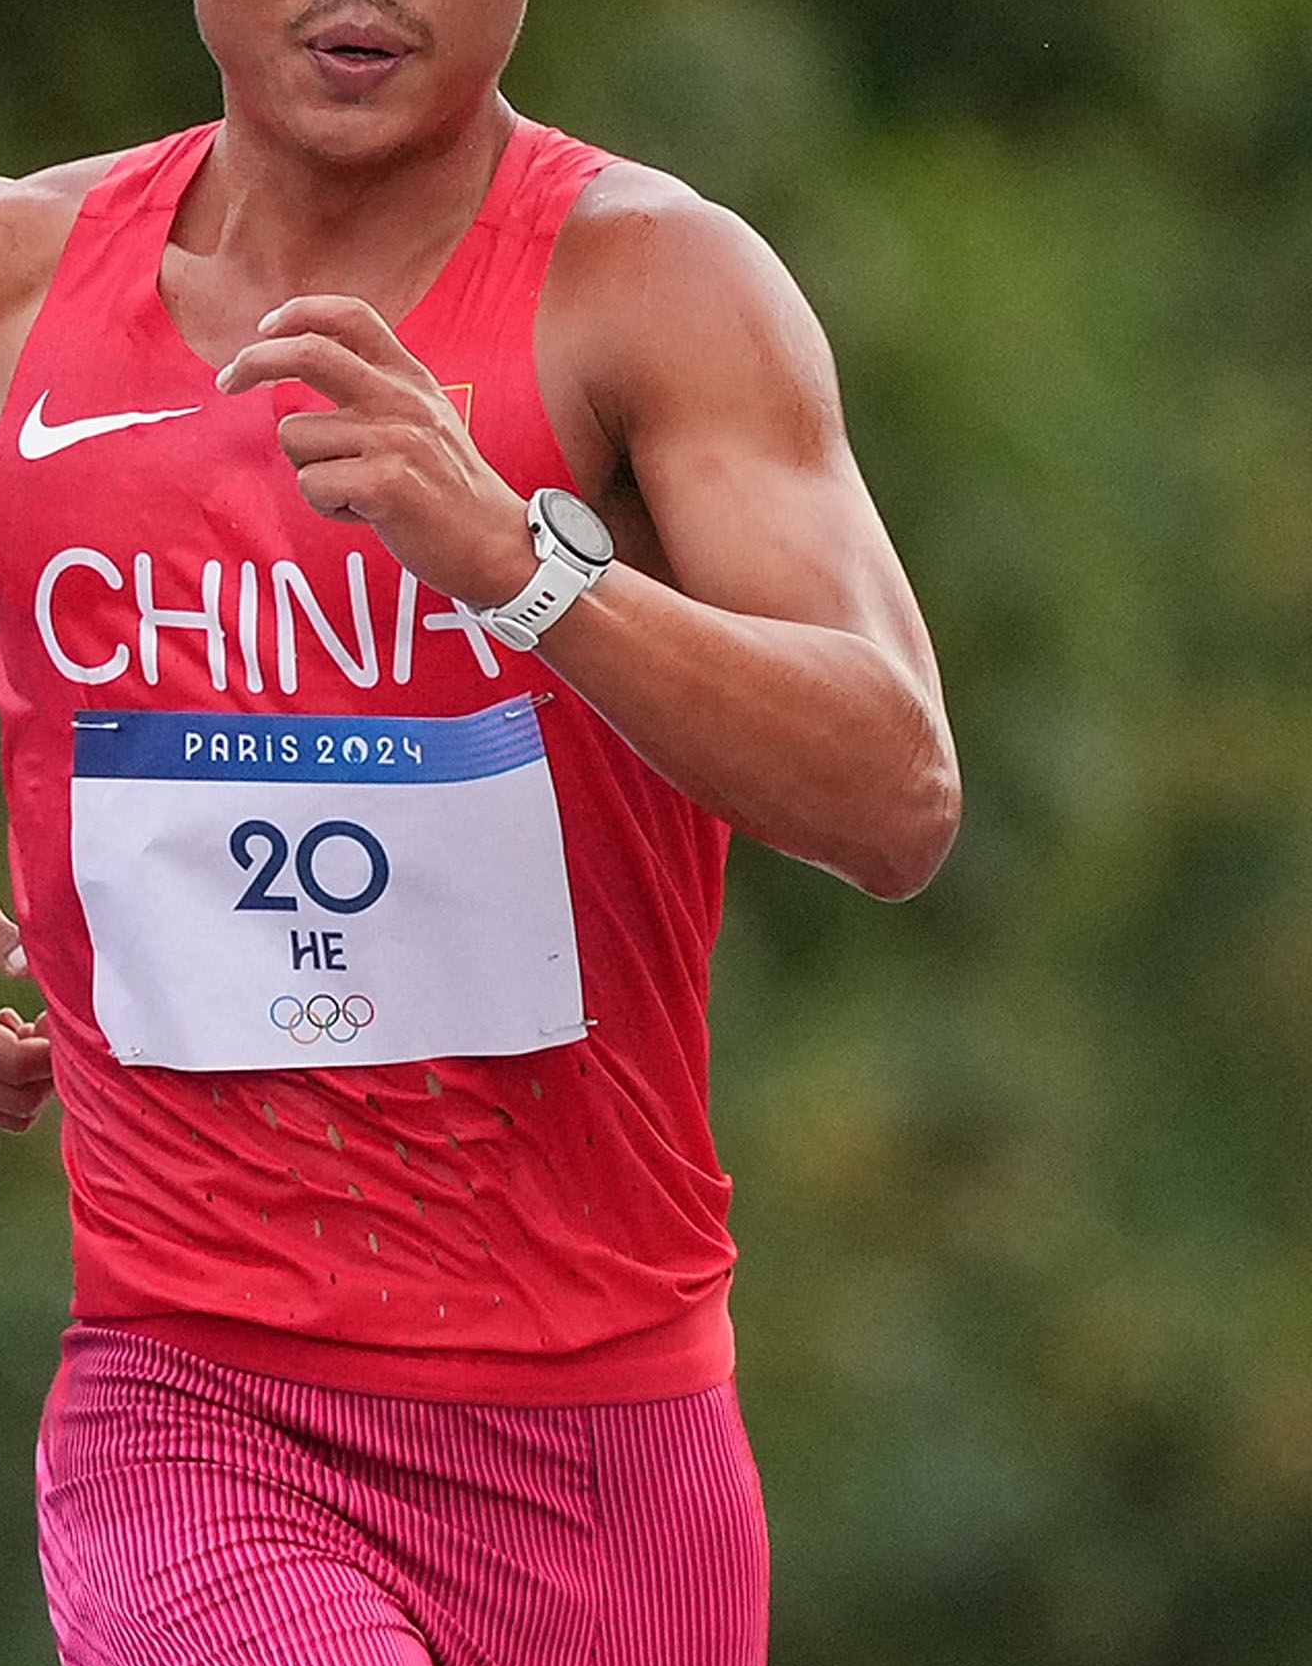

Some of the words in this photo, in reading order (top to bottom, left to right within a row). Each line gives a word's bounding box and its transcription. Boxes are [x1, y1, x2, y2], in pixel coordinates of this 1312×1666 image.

[34, 547, 501, 695] CHINA
[315, 734, 424, 766] 2024
[228, 819, 390, 915] 20
[289, 929, 349, 973] HE
